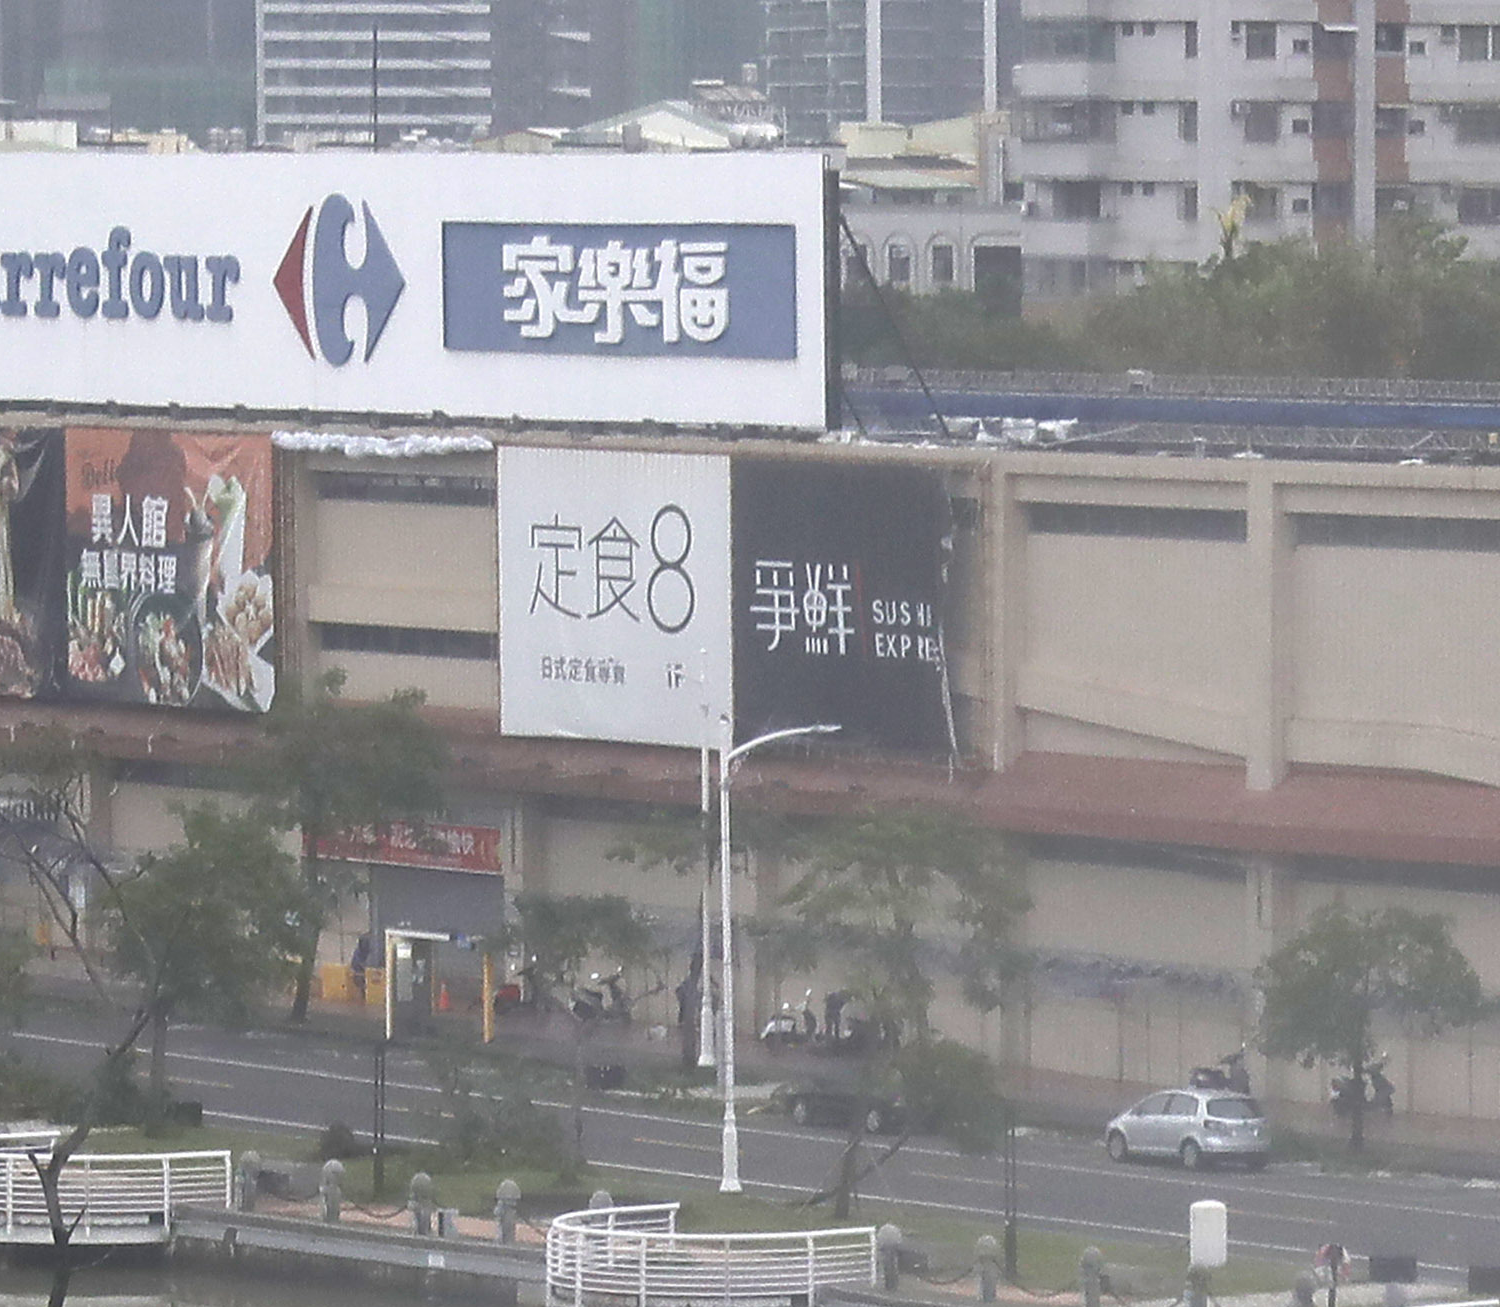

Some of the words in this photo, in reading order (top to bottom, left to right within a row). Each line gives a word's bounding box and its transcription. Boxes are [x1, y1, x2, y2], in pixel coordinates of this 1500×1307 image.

[501, 234, 731, 346] 家樂福
[91, 493, 169, 549] 異人館
[749, 559, 856, 656] 爭鮮
